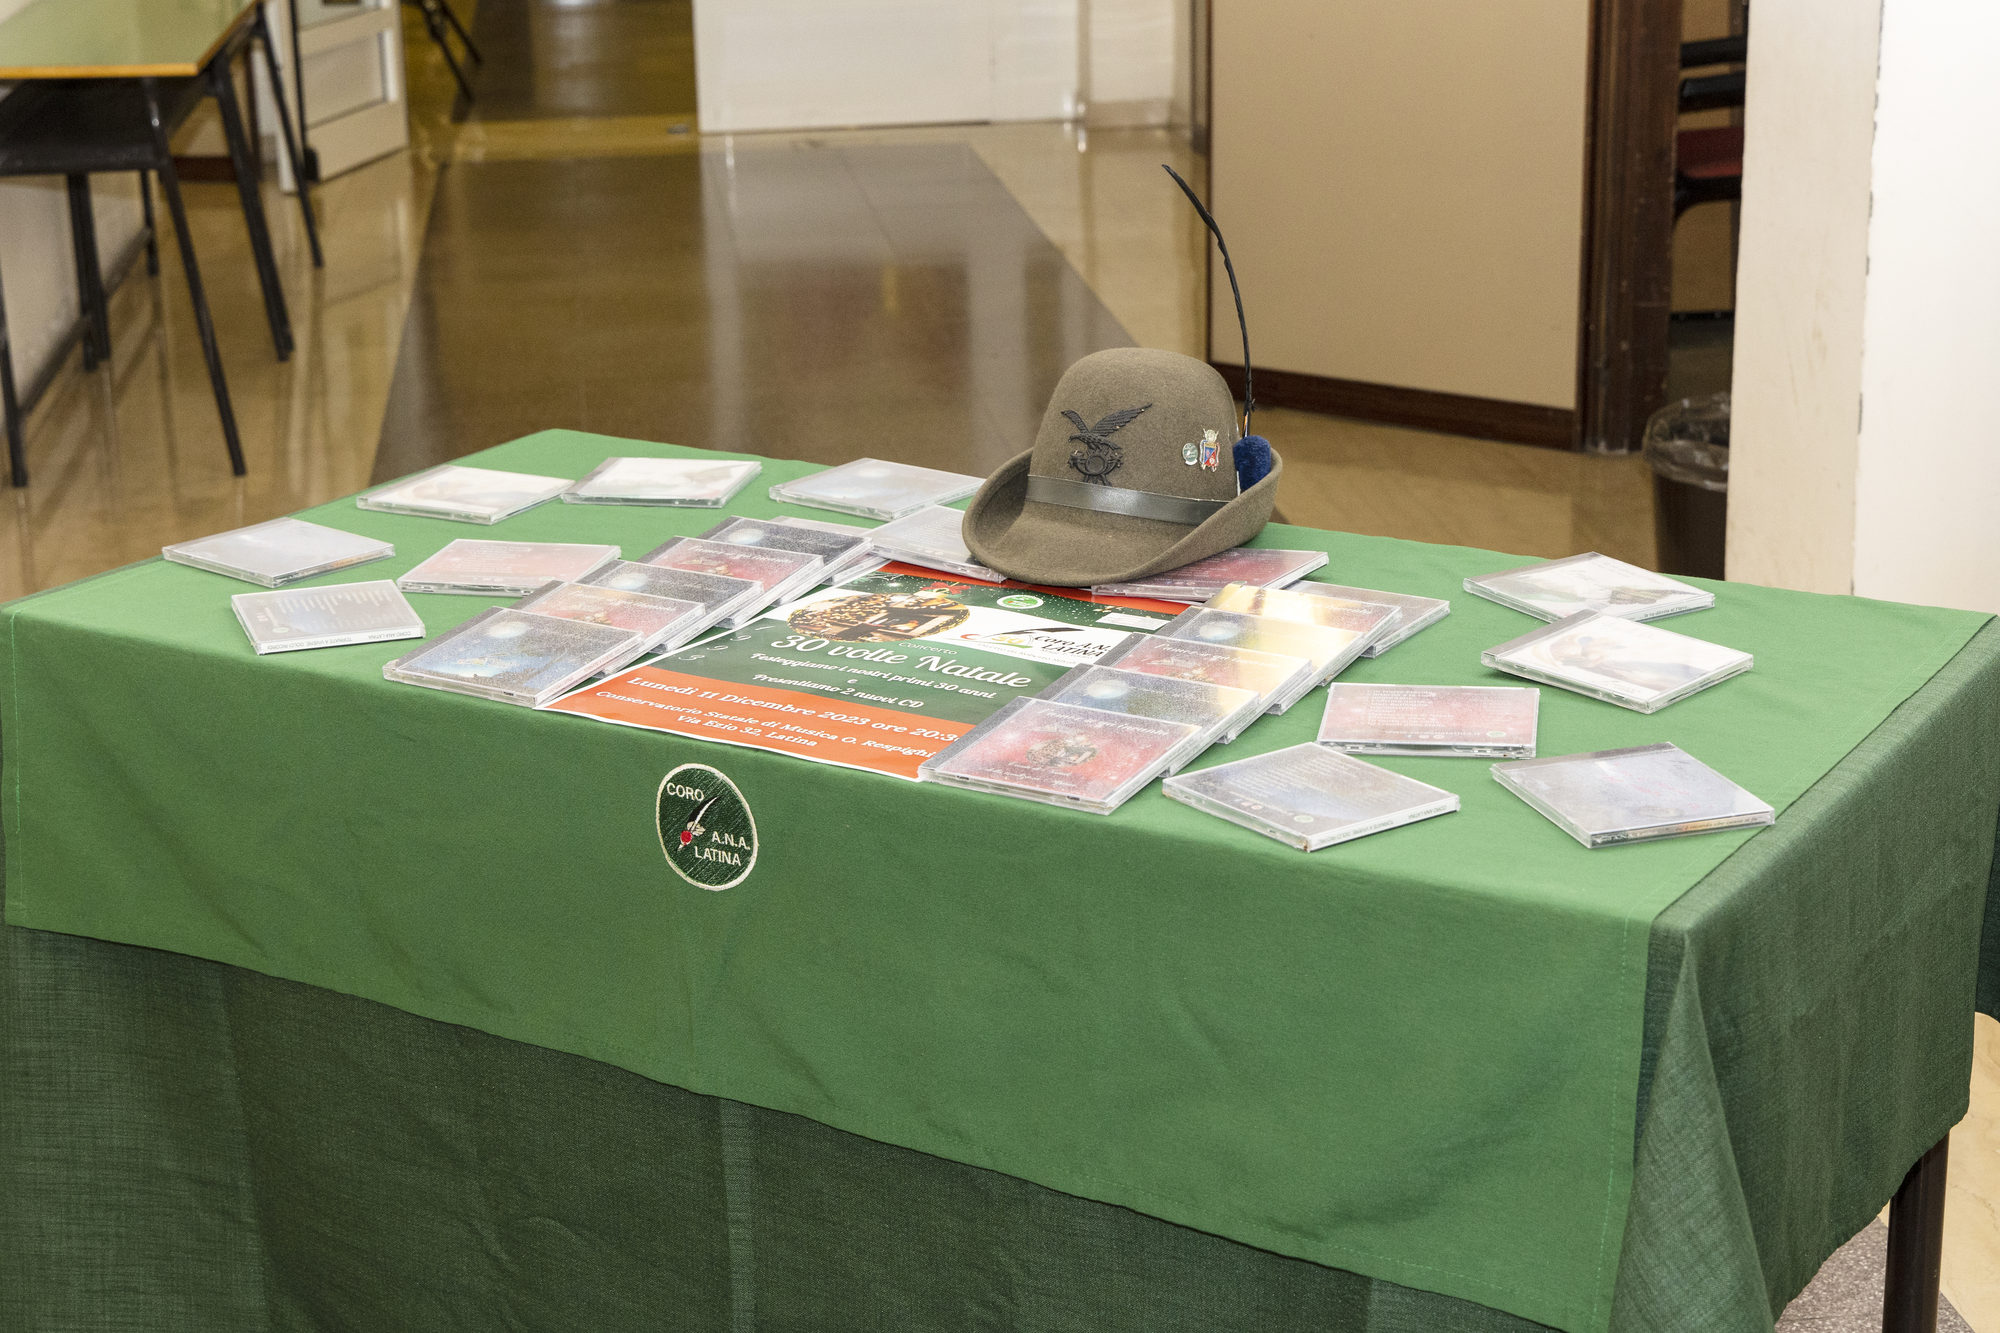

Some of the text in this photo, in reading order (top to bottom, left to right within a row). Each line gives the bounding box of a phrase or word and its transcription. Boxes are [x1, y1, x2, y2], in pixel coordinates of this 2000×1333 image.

[898, 642, 957, 655] Concerto
[1042, 644, 1103, 657] LATINA
[1076, 642, 1112, 652] A.N.
[770, 635, 1032, 688] 30 volte Natale
[751, 652, 840, 670] Festeggiamo
[846, 667, 891, 679] nostri
[888, 674, 936, 688] primi
[934, 681, 959, 691] 30
[958, 687, 998, 699] anni
[752, 673, 924, 708] Presentiamo 2 nuovi CD
[627, 676, 960, 742] Lunedì 11 Dicembre 2023 ore 20:3
[596, 690, 937, 758] Conservatorio Statale di Musica O. Respighi
[676, 714, 818, 747] Via Ezio 32, Latina
[666, 782, 705, 801] CORO
[711, 831, 751, 850] A.N.A.
[694, 845, 741, 866] LATINA
